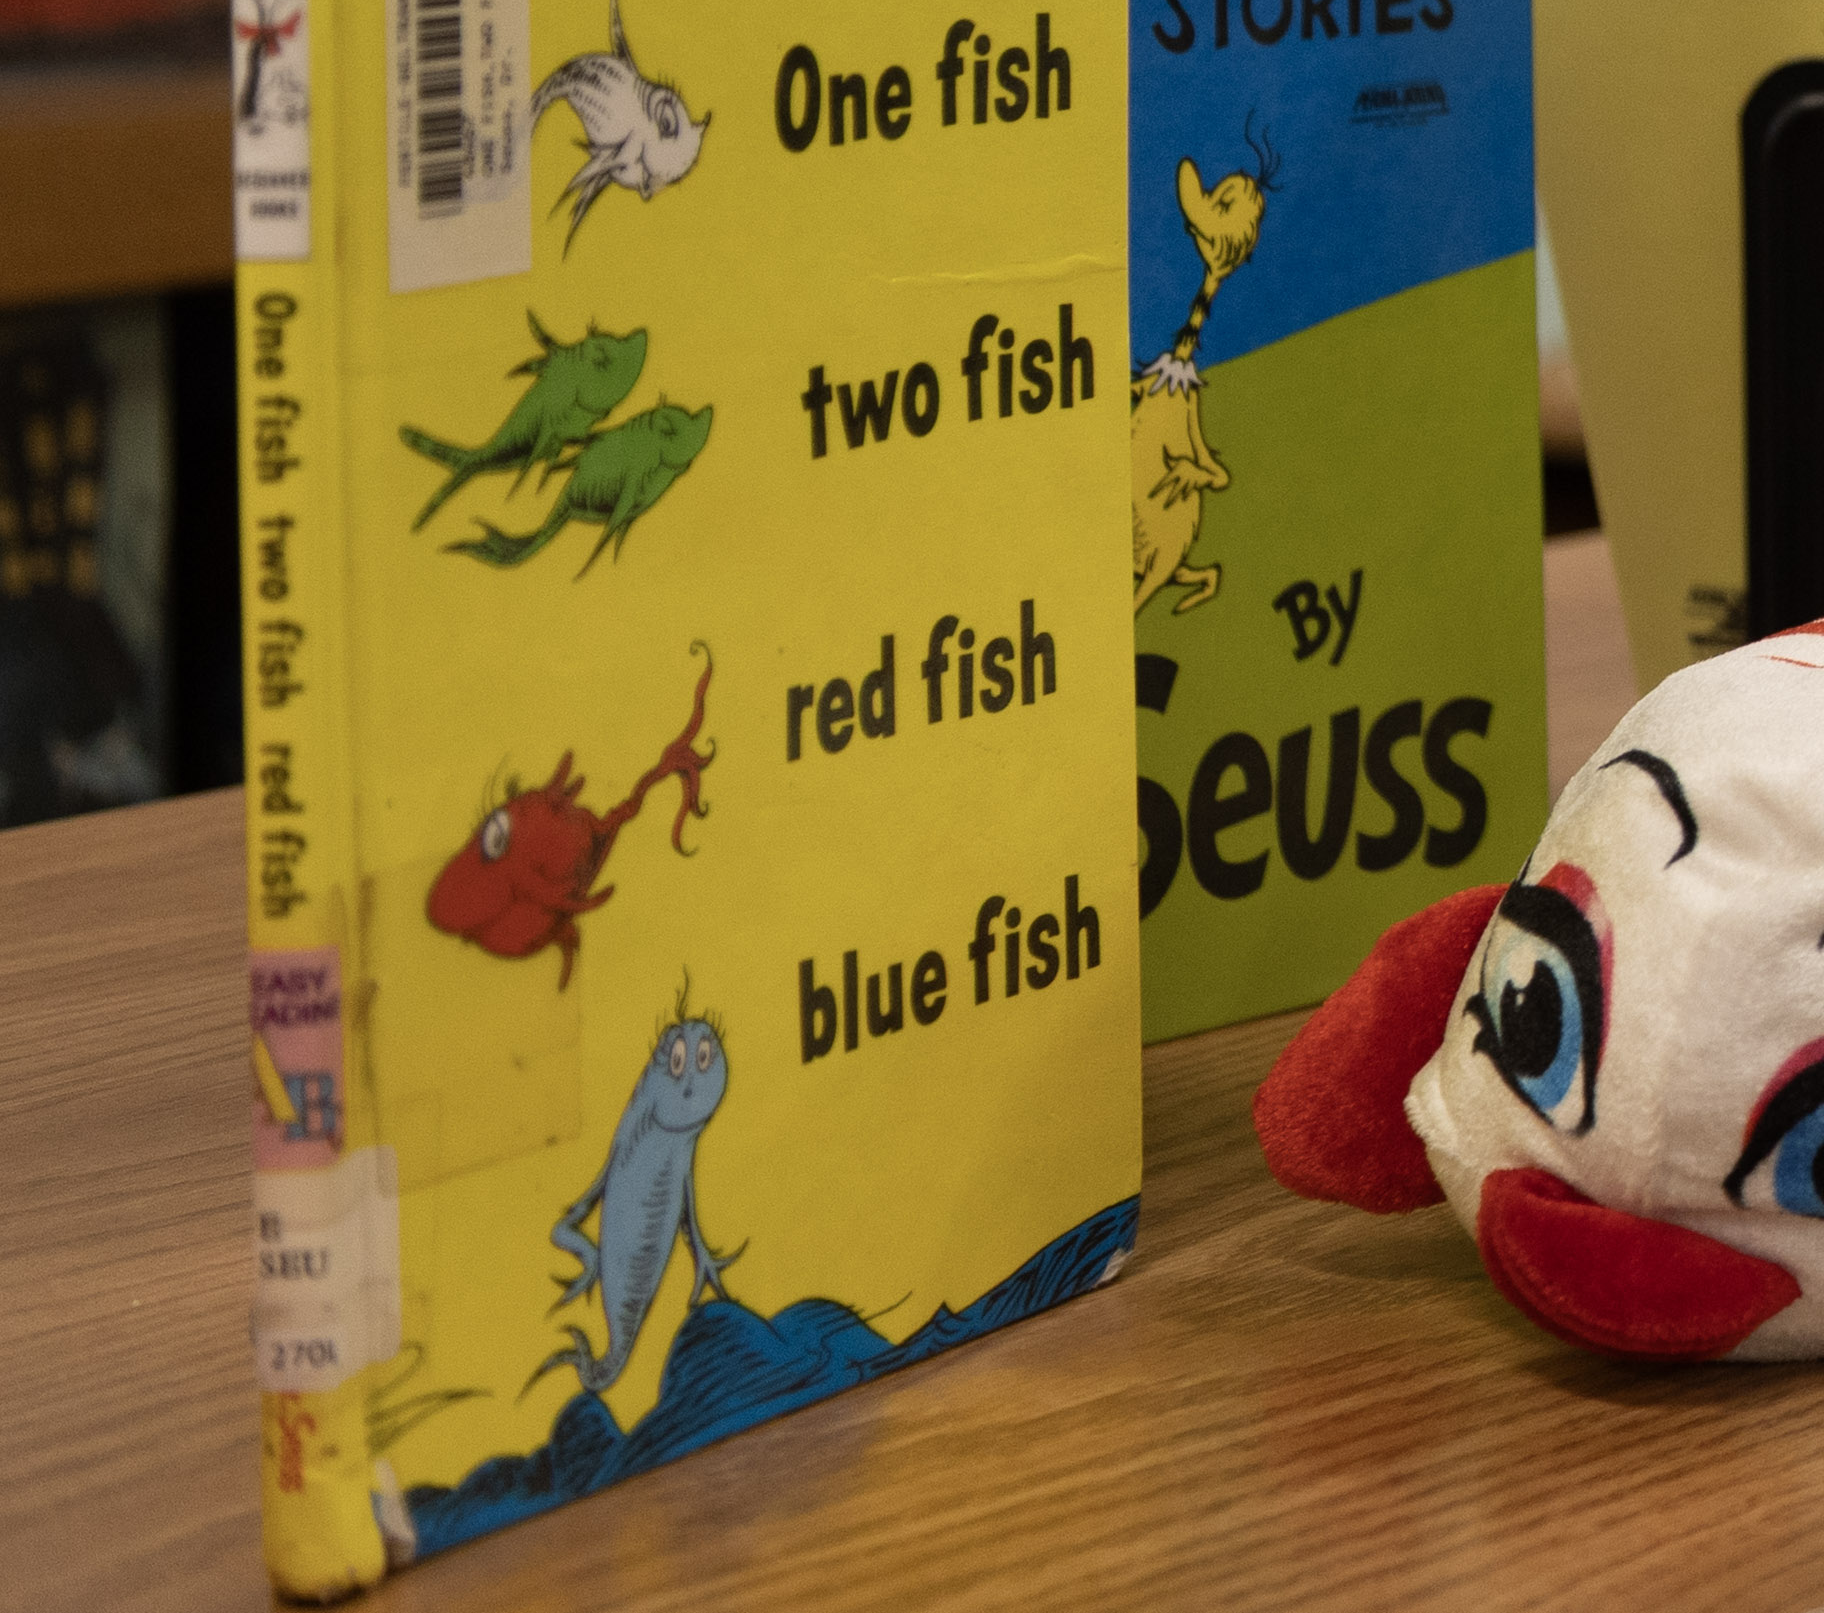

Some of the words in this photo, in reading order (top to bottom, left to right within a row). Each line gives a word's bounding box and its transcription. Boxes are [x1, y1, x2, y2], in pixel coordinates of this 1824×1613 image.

[774, 43, 914, 155] One
[935, 12, 1073, 130] fish
[253, 291, 299, 380] One
[802, 361, 940, 461] two
[960, 302, 1097, 423] fish
[255, 398, 303, 487] fish
[257, 512, 295, 604] two
[1271, 569, 1366, 666] By
[258, 621, 305, 711] fish
[785, 632, 897, 763] red
[921, 598, 1058, 725] fish
[260, 738, 305, 826] red
[261, 830, 307, 919] fish
[799, 939, 949, 1065] blue
[968, 872, 1102, 1007] fish
